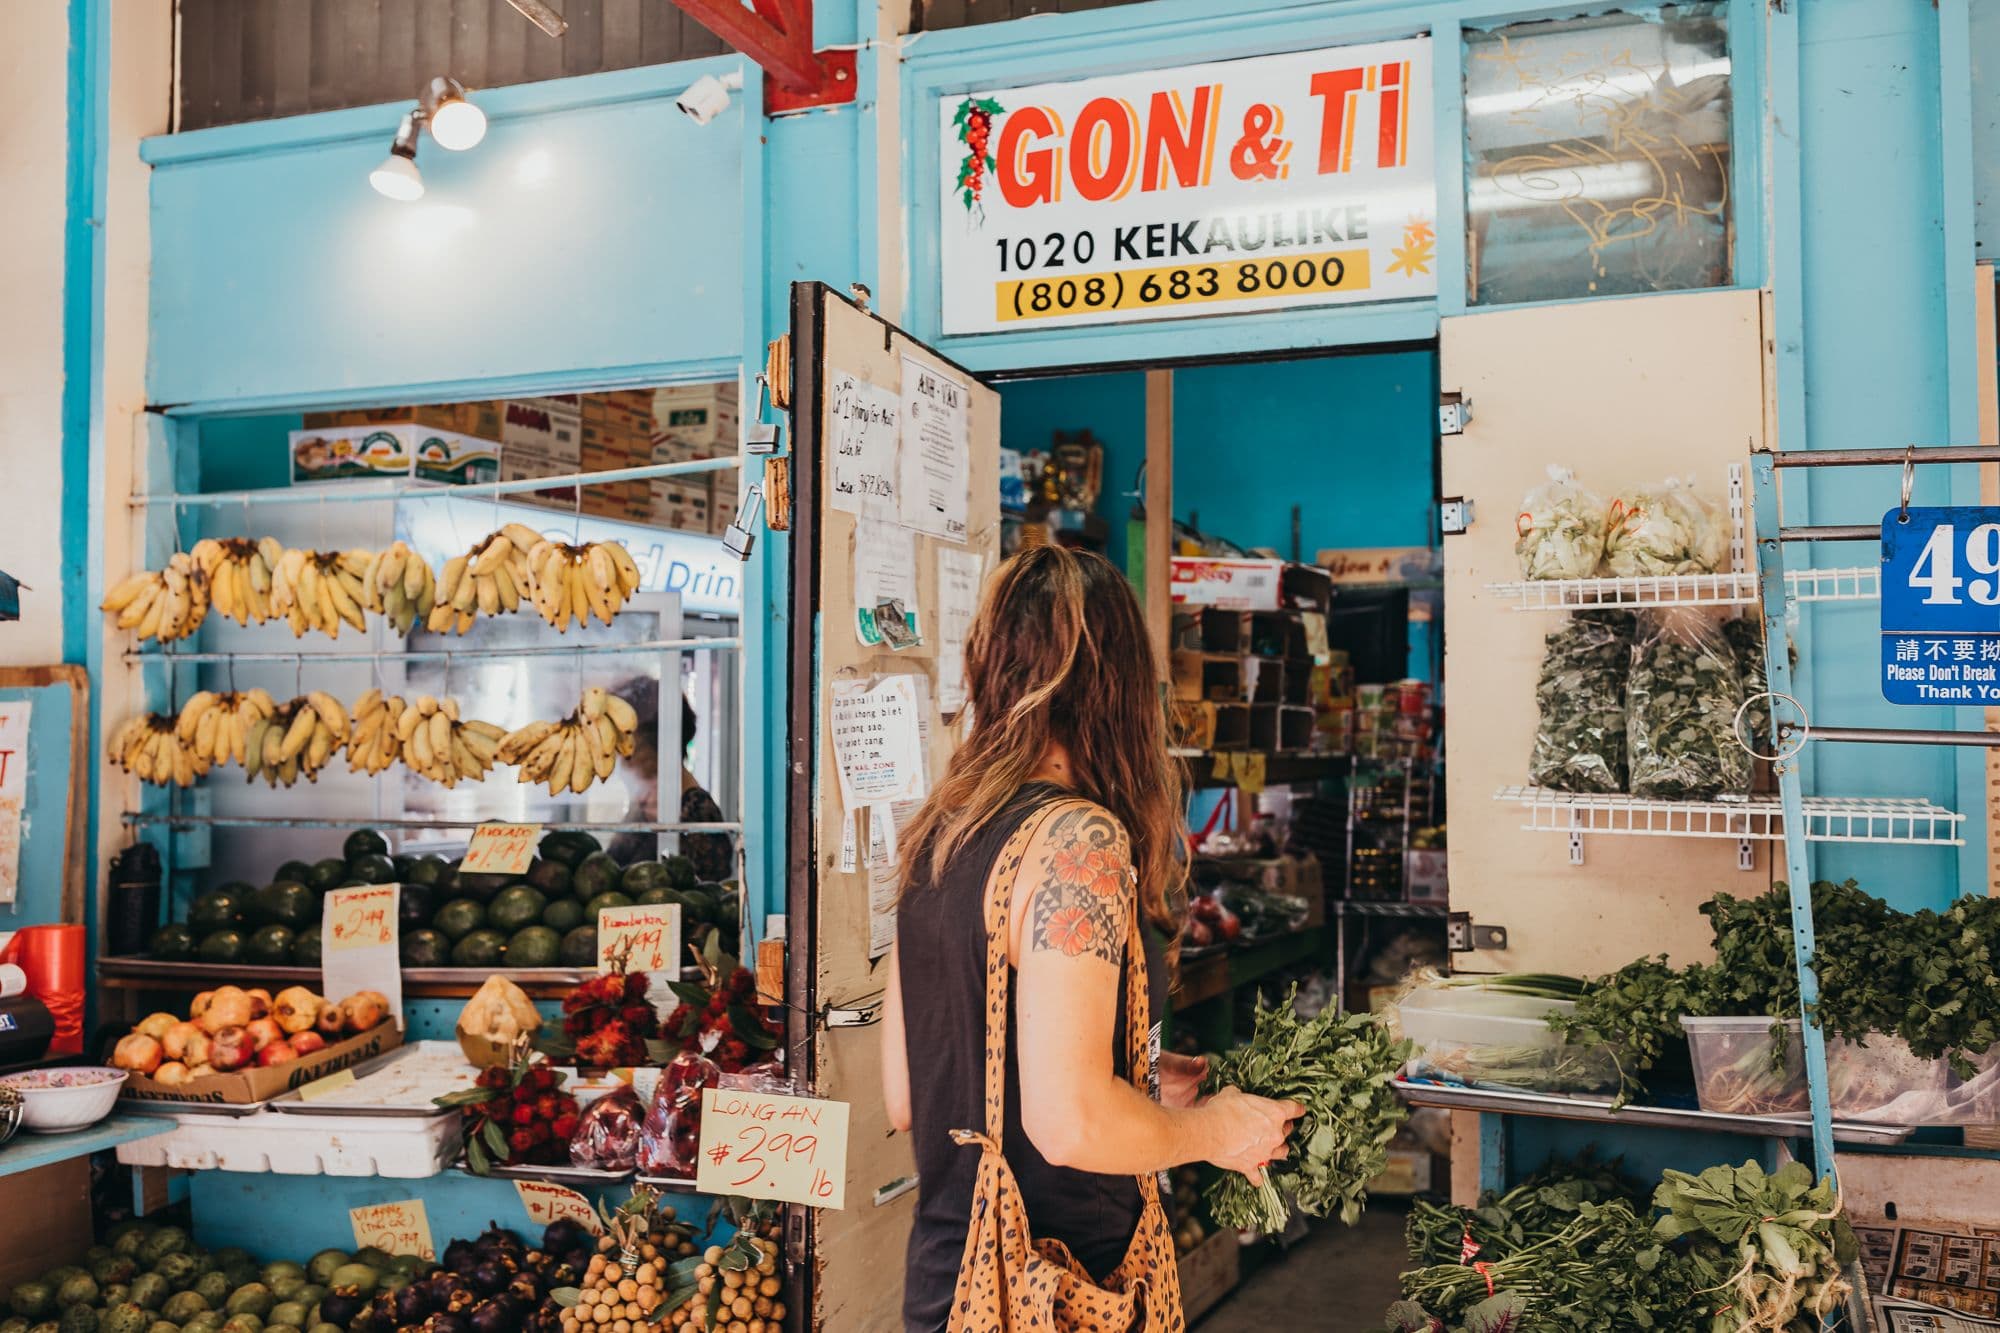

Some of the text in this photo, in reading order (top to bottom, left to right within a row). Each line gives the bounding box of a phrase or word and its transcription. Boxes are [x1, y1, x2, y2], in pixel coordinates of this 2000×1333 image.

[996, 83, 1223, 208] GON
[1230, 103, 1293, 182] &
[996, 204, 1368, 272] 1020 KEKAULIKE
[1013, 257, 1345, 316] (808) 683 8000
[665, 560, 740, 598] Drin
[1887, 664, 1996, 681] Please Don't Break
[1916, 684, 1973, 699] Thank
[874, 761, 896, 770] ZONE
[810, 1167, 833, 1197] lb
